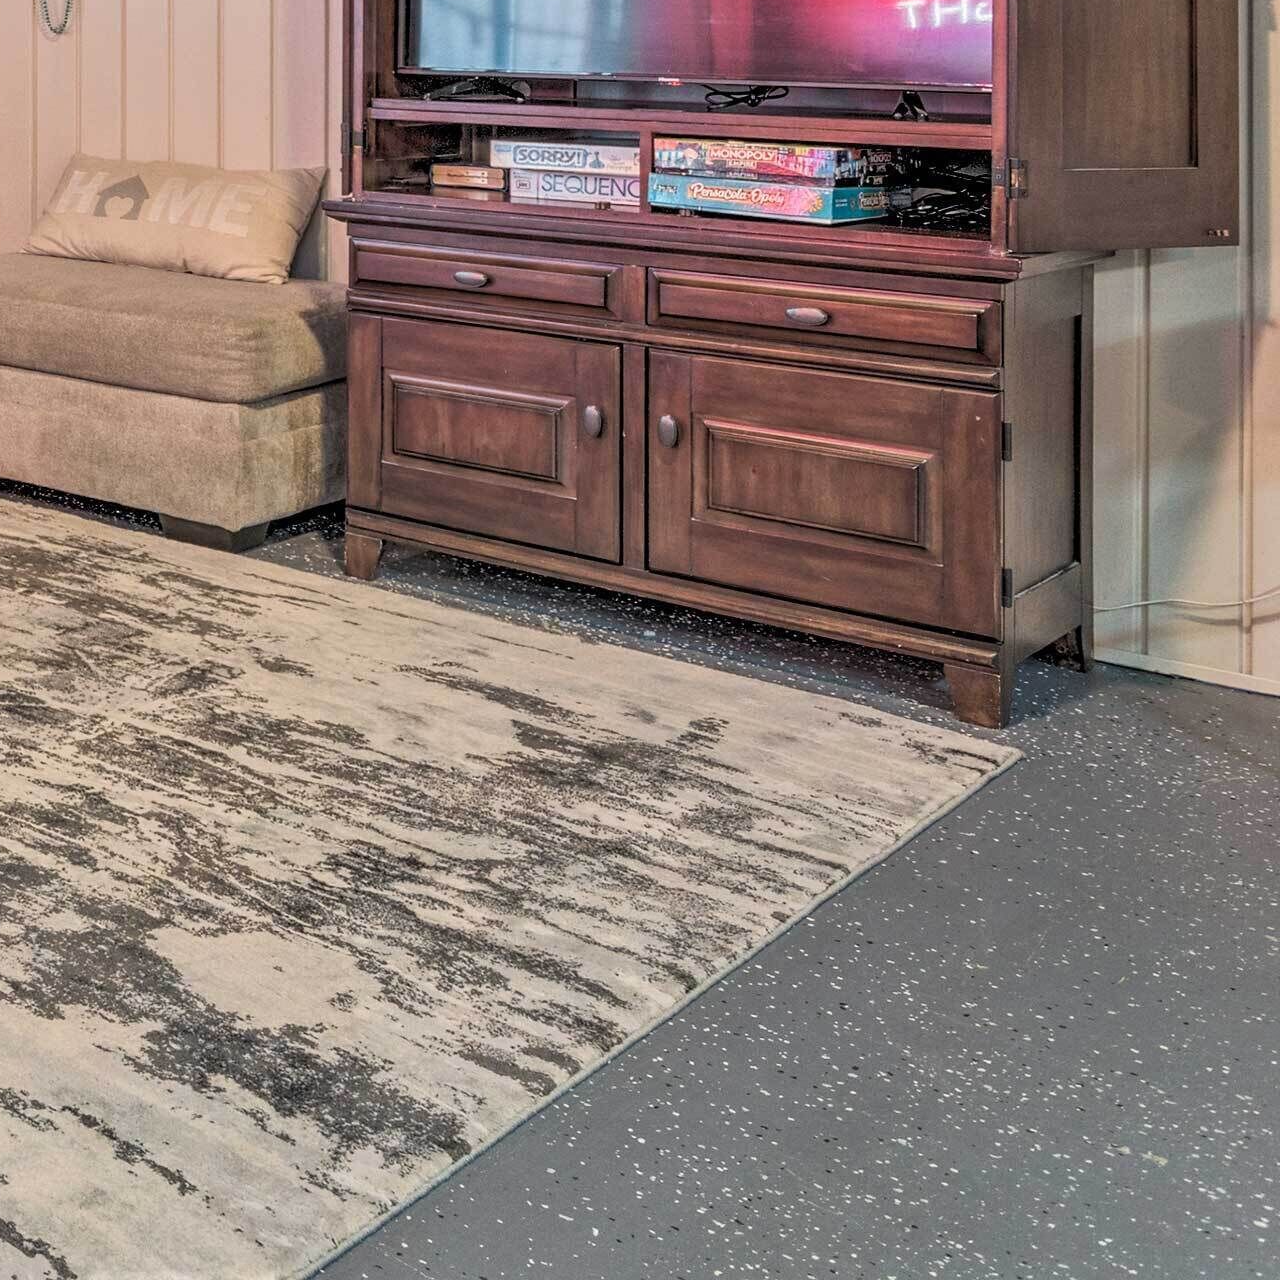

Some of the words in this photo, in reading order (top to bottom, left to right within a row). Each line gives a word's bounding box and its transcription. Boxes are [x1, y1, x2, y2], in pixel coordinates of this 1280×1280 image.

[518, 148, 582, 165] SORRY!
[710, 150, 775, 160] MONOPOLY
[54, 171, 267, 238] HME
